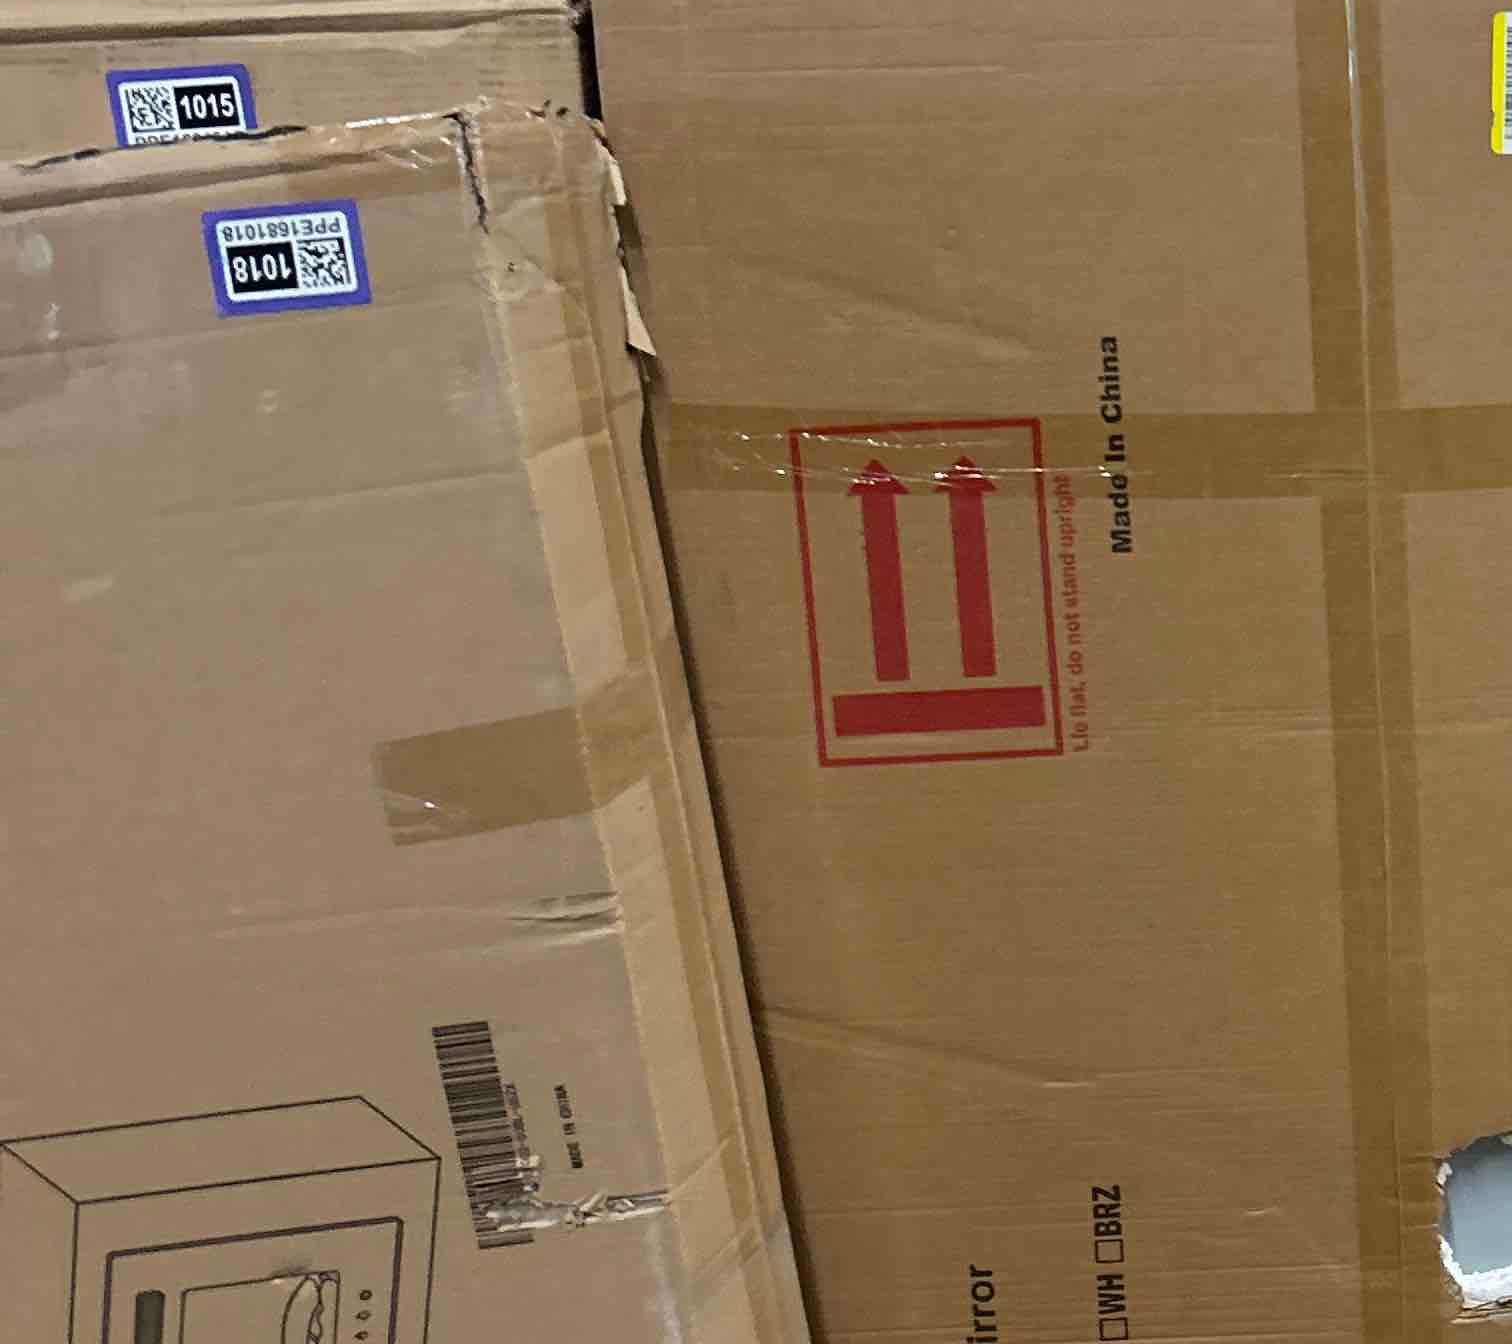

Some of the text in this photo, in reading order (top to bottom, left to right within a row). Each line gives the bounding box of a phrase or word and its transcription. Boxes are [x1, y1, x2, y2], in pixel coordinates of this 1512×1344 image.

[179, 93, 235, 120] 1015
[223, 217, 342, 242] PPE1681018
[232, 253, 292, 283] 1018
[1098, 336, 1121, 424] China
[1051, 475, 1078, 549] upright
[1109, 474, 1132, 553] Made
[1058, 554, 1079, 609] stand
[1064, 612, 1081, 647] not
[1067, 652, 1084, 675] do
[1091, 1184, 1121, 1237] BRZ
[1098, 1272, 1125, 1315] WH
